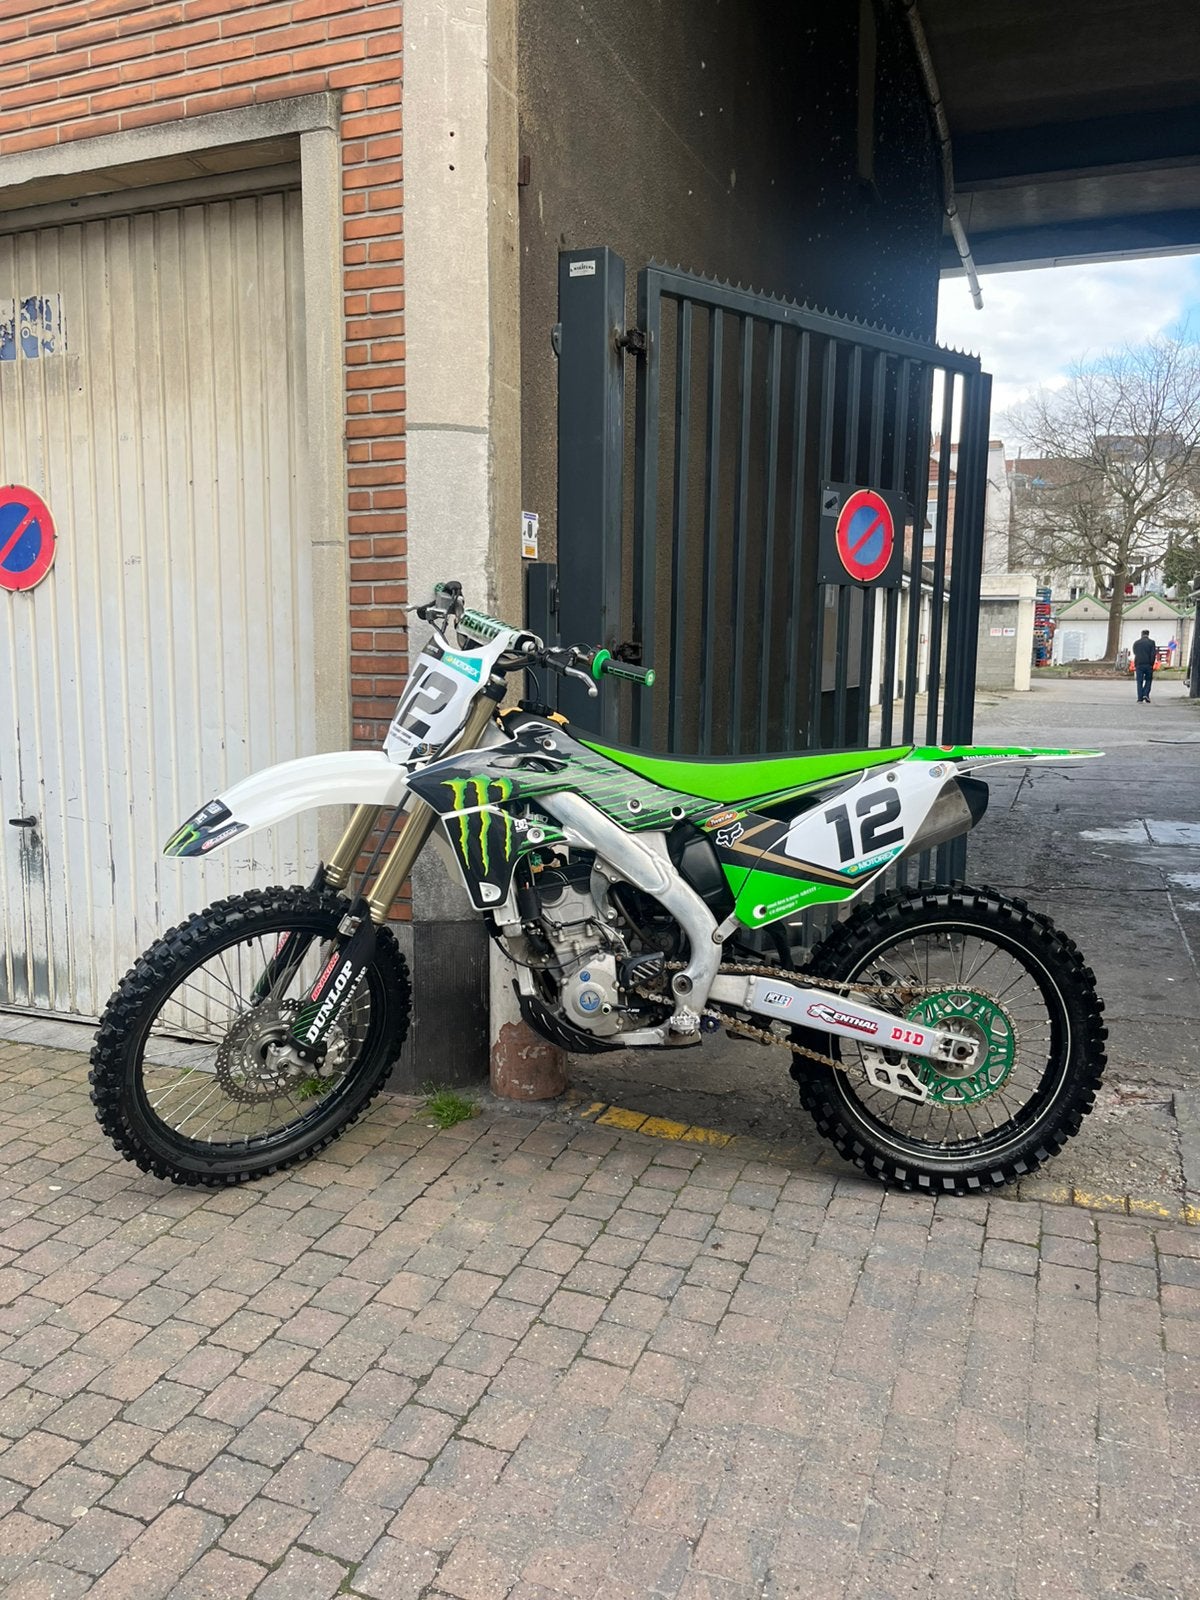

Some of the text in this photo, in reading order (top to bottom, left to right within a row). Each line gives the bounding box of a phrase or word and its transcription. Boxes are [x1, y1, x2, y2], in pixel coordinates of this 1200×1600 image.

[461, 614, 501, 638] RENTH
[392, 663, 458, 740] 12
[824, 787, 904, 863] 12
[858, 850, 896, 870] MOTOREX
[306, 960, 352, 1043] DUNLOP
[807, 1004, 878, 1031] RENTHAL
[891, 1027, 925, 1046] DID
